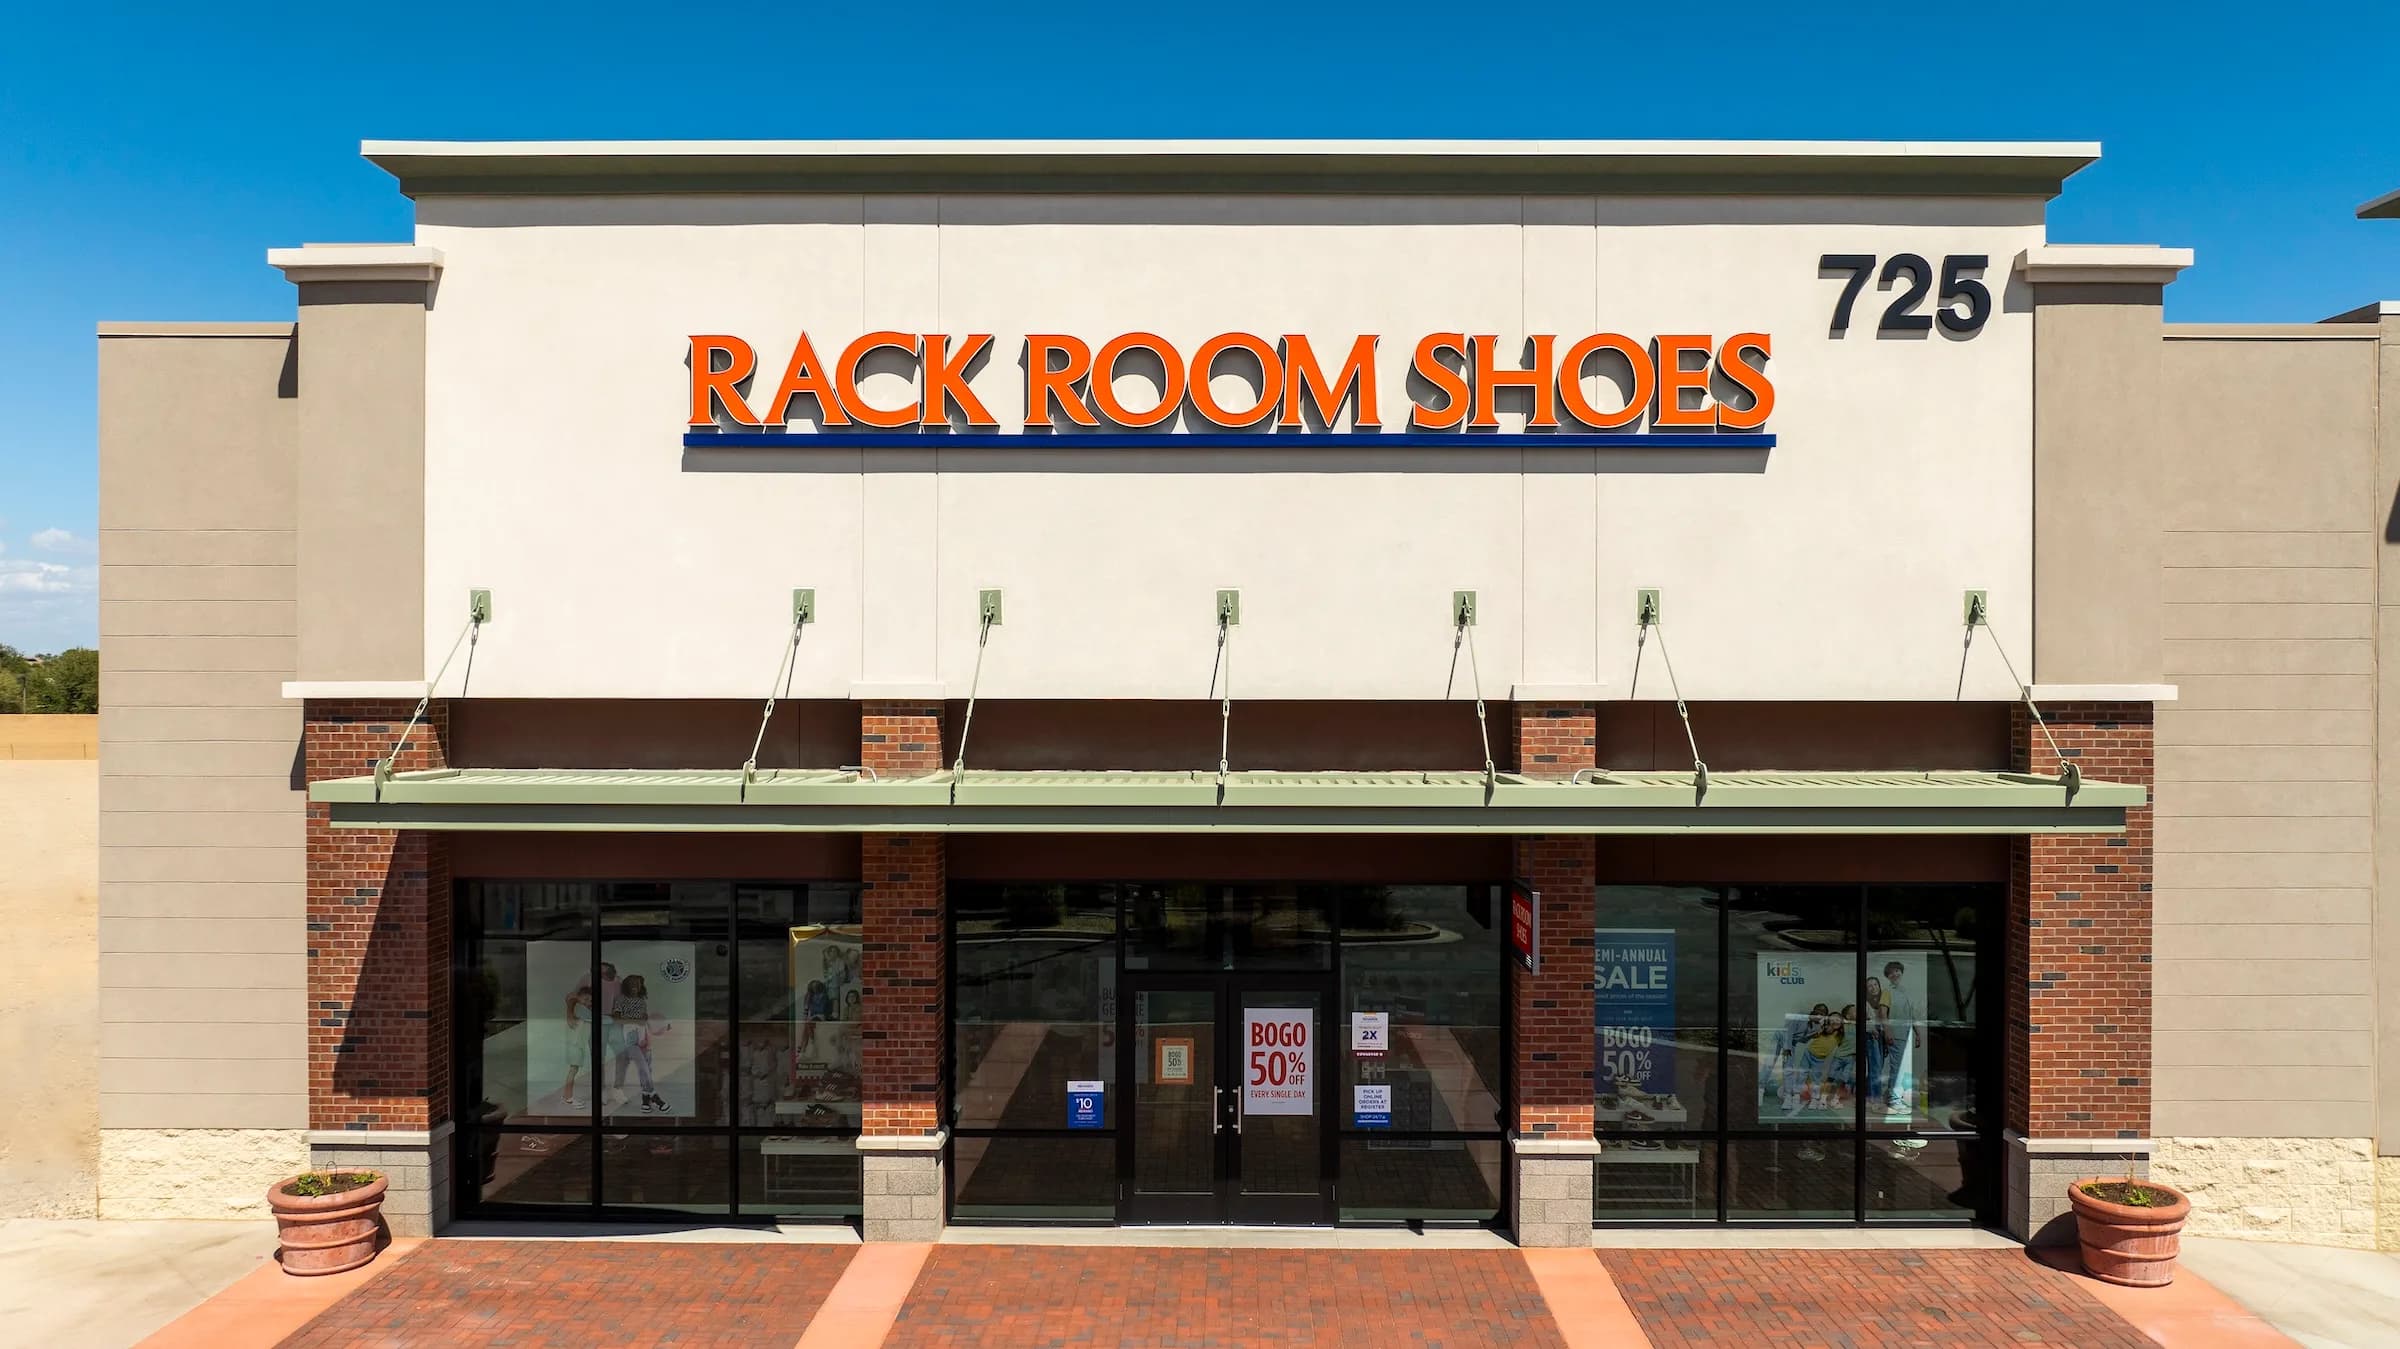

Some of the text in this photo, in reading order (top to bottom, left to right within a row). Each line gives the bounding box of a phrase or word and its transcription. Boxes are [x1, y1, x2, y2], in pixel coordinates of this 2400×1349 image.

[1818, 253, 1992, 333] 725
[687, 330, 1776, 430] RACK ROOM SHOES
[1595, 948, 1667, 963] EMI-ANNUAL
[1594, 965, 1668, 990] SALE
[1766, 961, 1799, 977] kids
[1780, 976, 1805, 985] CLUB
[1251, 1022, 1306, 1047] BOGO
[1362, 1030, 1377, 1040] 2X
[1604, 1026, 1652, 1048] BOGO
[1250, 1051, 1306, 1086] 50% OFF
[1603, 1050, 1652, 1081] 50% OFF
[1250, 1090, 1306, 1098] EVERY SINGLE DAY
